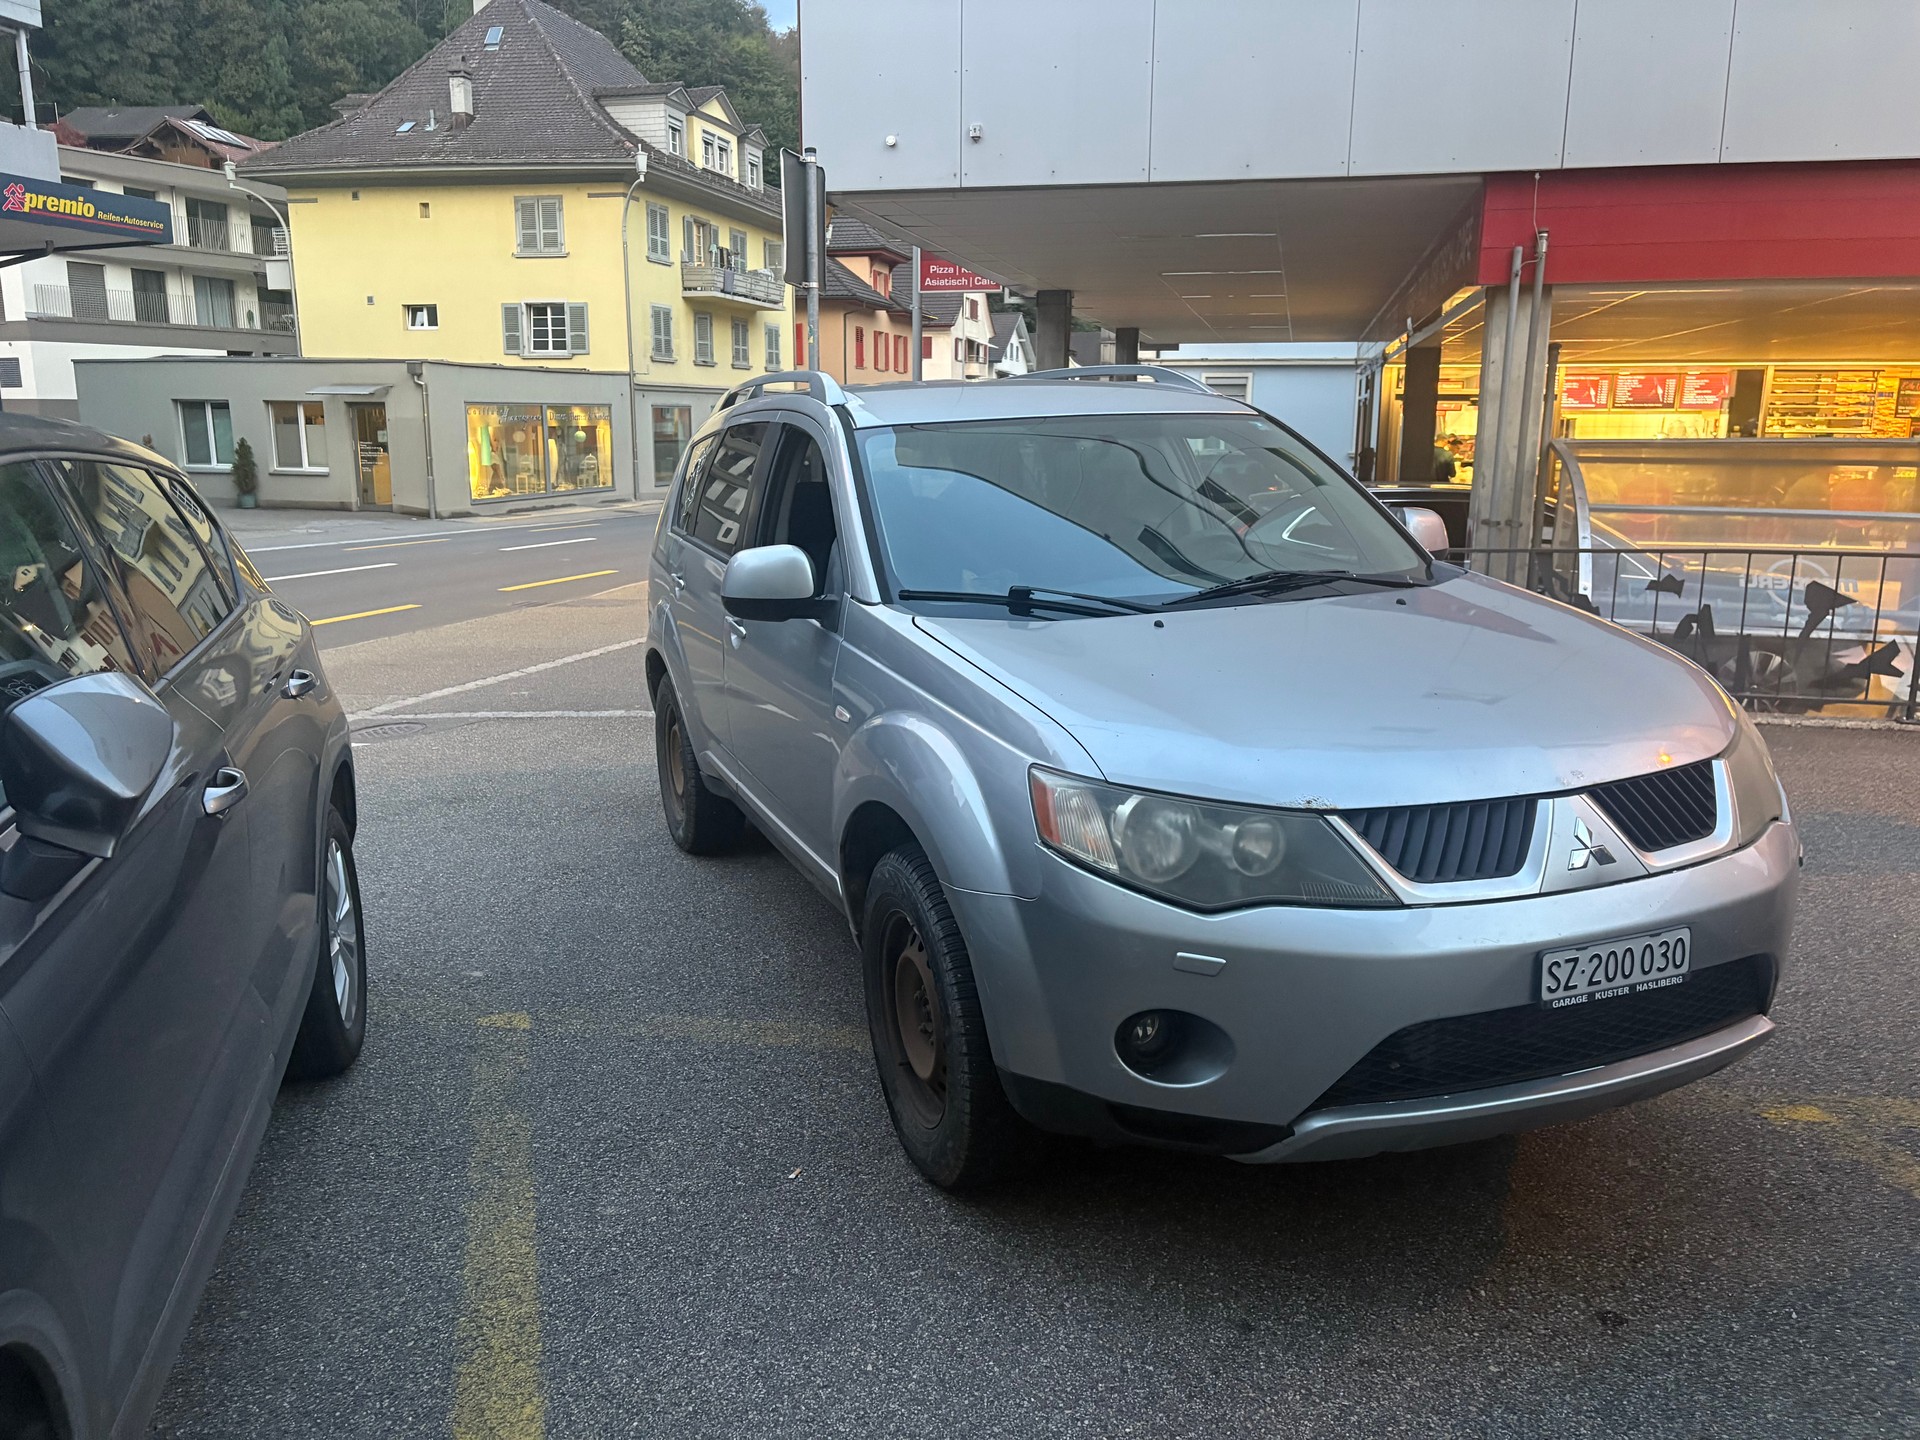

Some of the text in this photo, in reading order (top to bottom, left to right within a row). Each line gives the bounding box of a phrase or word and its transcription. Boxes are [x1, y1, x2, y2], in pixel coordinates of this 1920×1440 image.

[24, 192, 95, 218] premio
[98, 211, 164, 230] Reifen+Autoservice
[930, 265, 954, 274] Pizza
[925, 277, 968, 286] Asiatisch
[1552, 975, 1683, 1009] GARAGE KUSTER HASLIBERG
